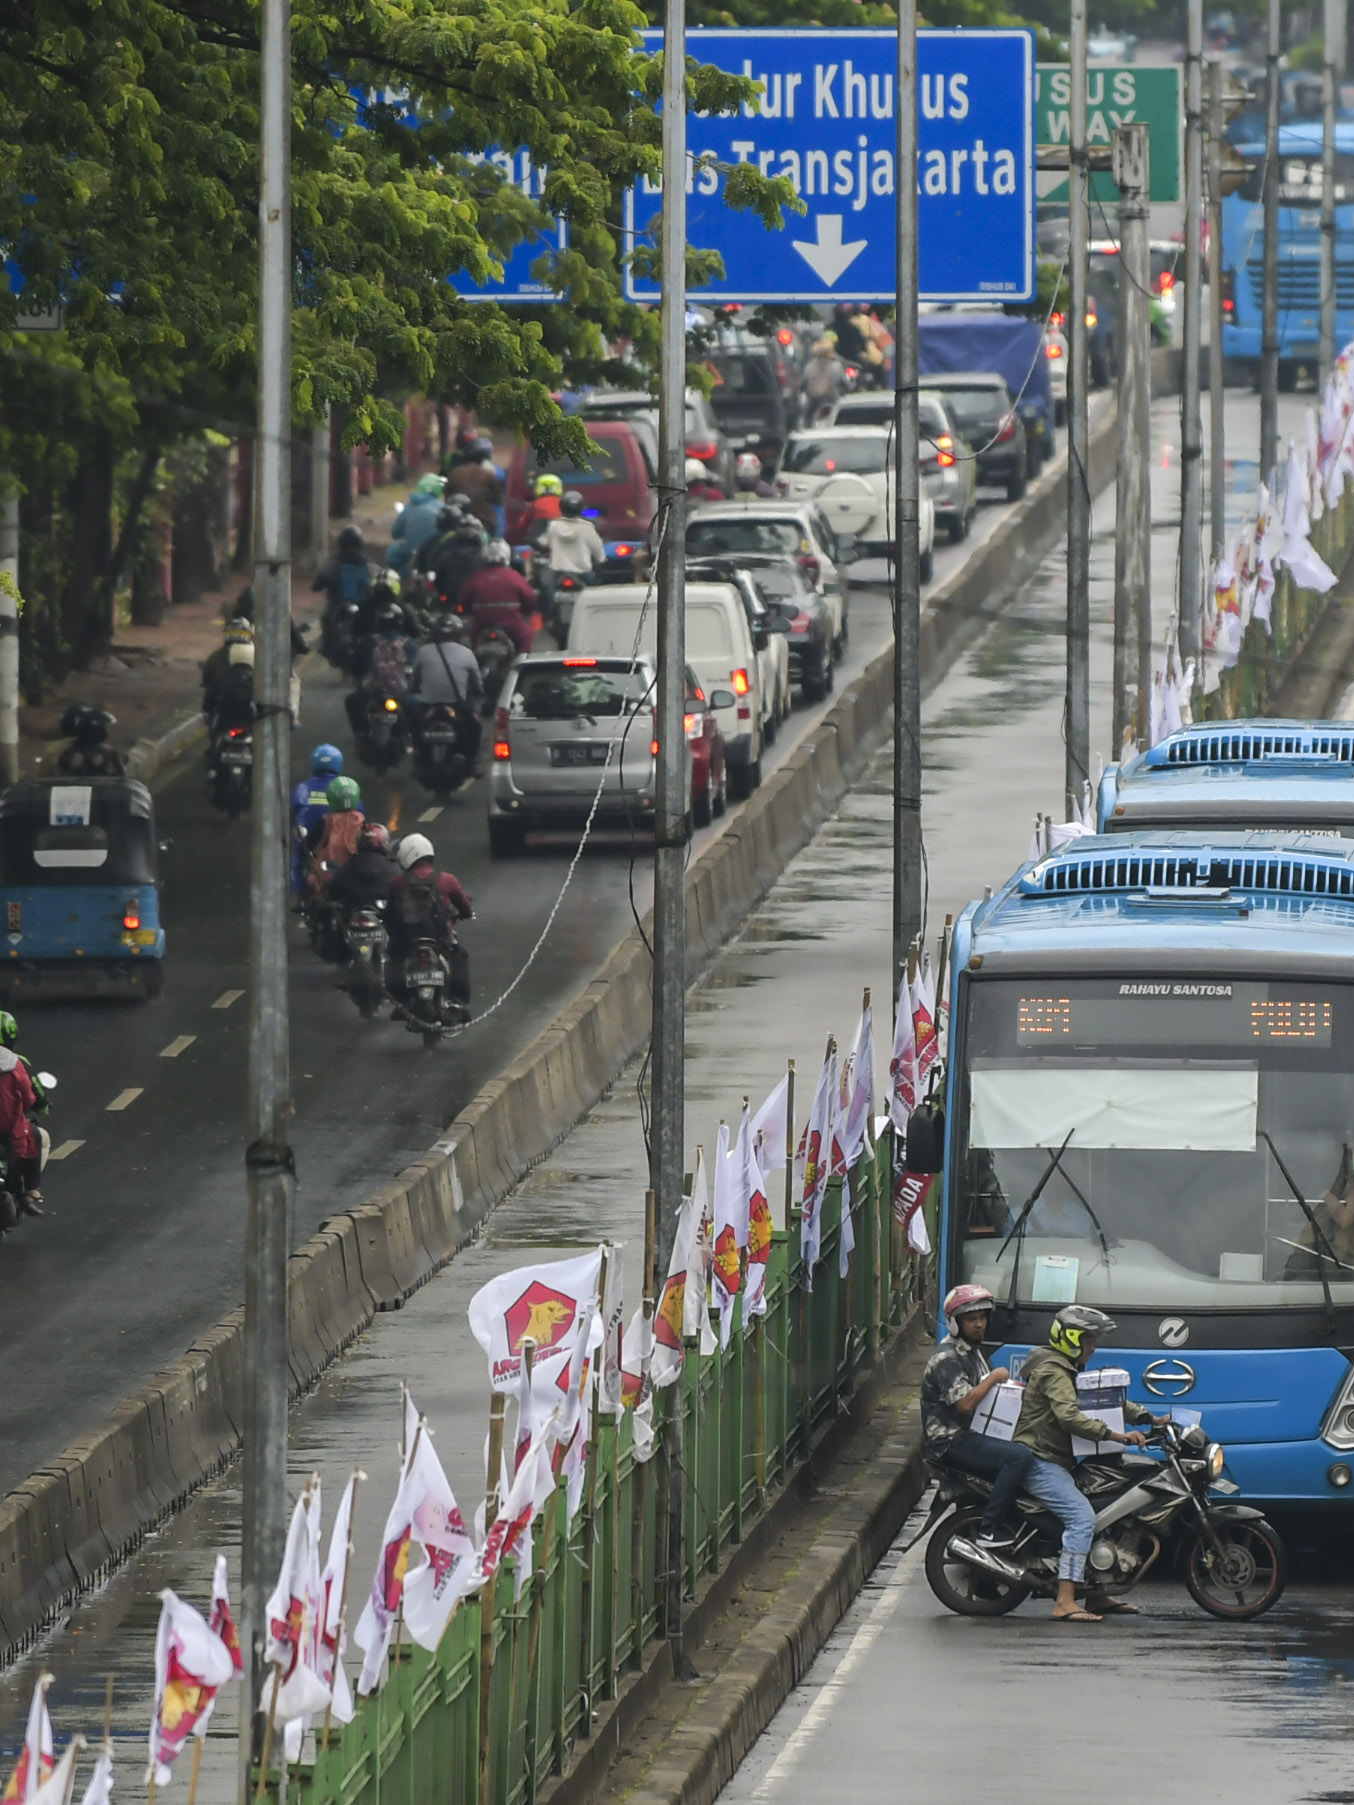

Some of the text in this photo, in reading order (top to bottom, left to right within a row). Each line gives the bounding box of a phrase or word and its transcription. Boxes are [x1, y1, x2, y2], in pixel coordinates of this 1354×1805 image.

[694, 60, 970, 118] lur Khuus
[1118, 985, 1232, 997] RAHAYU SANTOSA
